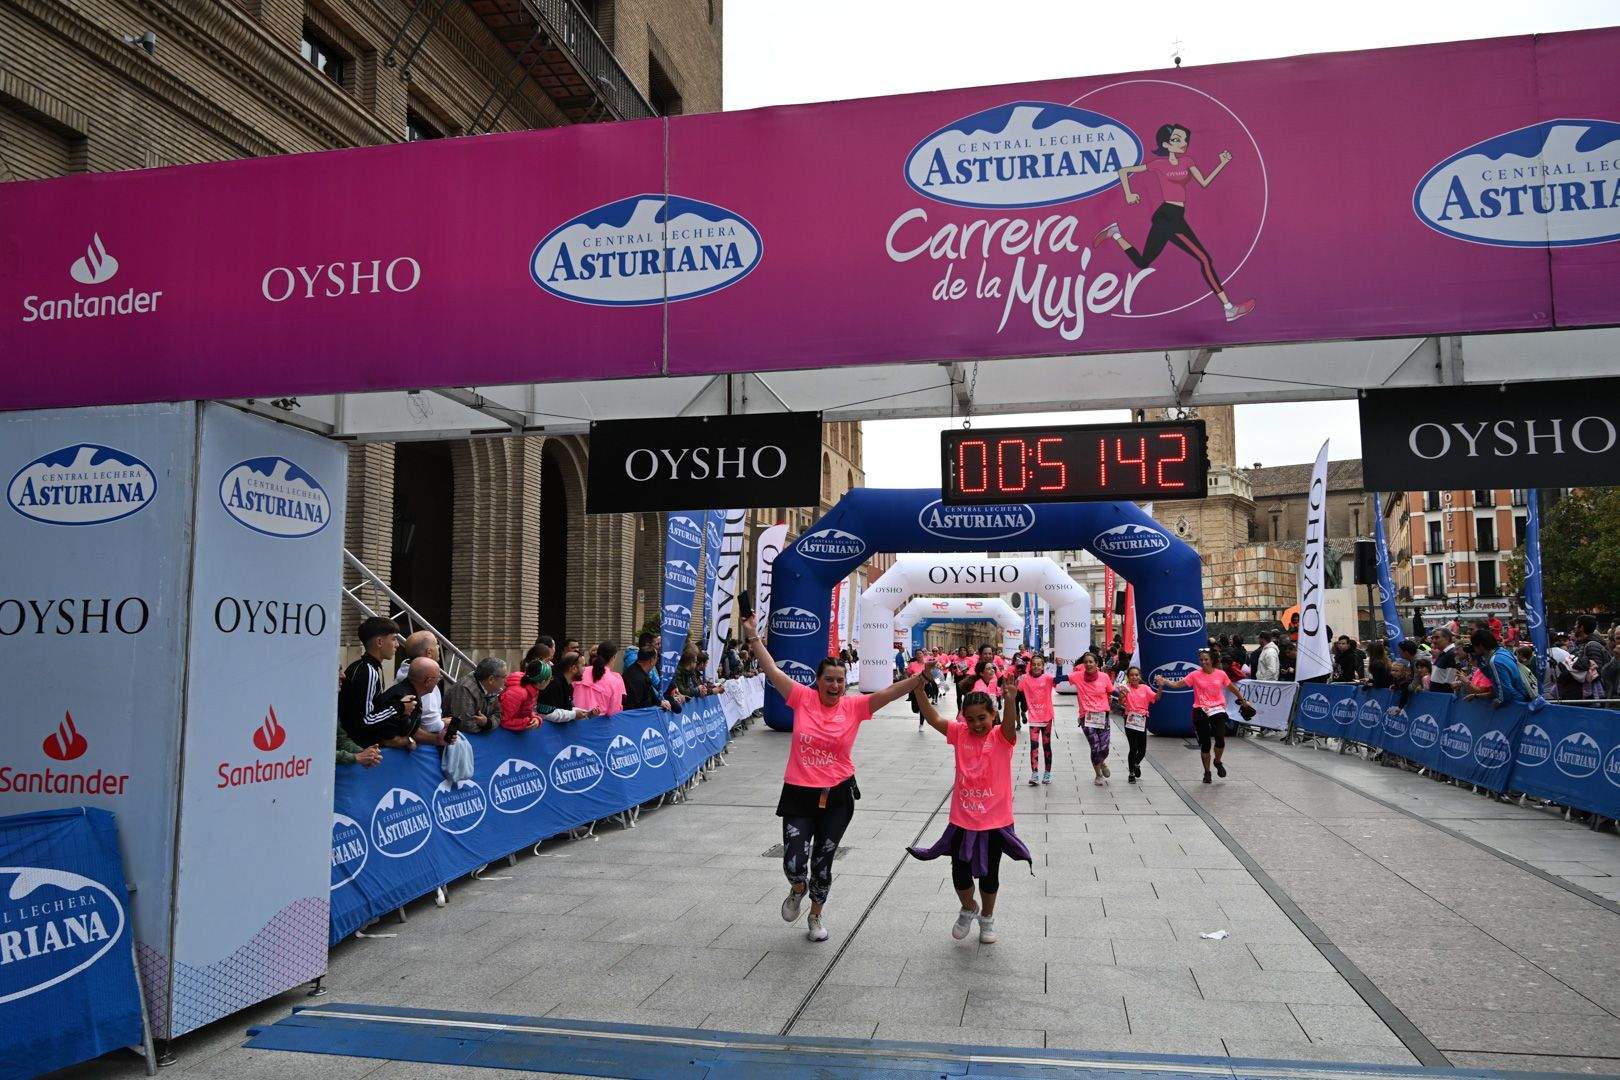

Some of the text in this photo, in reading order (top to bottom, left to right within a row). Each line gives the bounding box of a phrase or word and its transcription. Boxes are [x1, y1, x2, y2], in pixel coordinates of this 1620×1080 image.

[957, 131, 1116, 154] CENTRAL LECHERA
[922, 145, 1124, 187] ASTURIANA
[1481, 163, 1576, 181] CENTRAL
[582, 226, 736, 248] CENTRAL LECHERA
[885, 207, 1080, 263] Carrera
[546, 241, 745, 282] ASTURIANA
[261, 256, 421, 302] OYSHO
[932, 246, 1156, 341] de la Mujer
[22, 287, 163, 323] Santander
[1408, 416, 1617, 460] OYSHO
[42, 470, 142, 482] CENTRAL LECHERA
[624, 445, 788, 482] OYSHO
[17, 476, 146, 507] ASTURIANA
[227, 476, 324, 524] ASTURIANA
[247, 478, 283, 493] CENTRAL
[927, 508, 1027, 529] ASTURIANA
[1444, 490, 1453, 533] OTEL
[800, 540, 860, 554] ASTURIANA
[1099, 538, 1166, 551] ASTURIANA
[1302, 477, 1321, 637] OYSHO
[928, 564, 1019, 584] OYSHO
[0, 597, 150, 636] OYSHO
[215, 596, 327, 637] OYSHO
[1059, 621, 1087, 629] OYSHO
[862, 659, 888, 667] OYSHO
[0, 766, 130, 795] Santander
[217, 755, 312, 789] Santander
[554, 762, 601, 786] ASTURIANA
[494, 778, 544, 806] ASTURIANA
[436, 796, 484, 824] ASTURIANA
[378, 812, 430, 848] ASTURIANA
[20, 894, 97, 920] LECHERA
